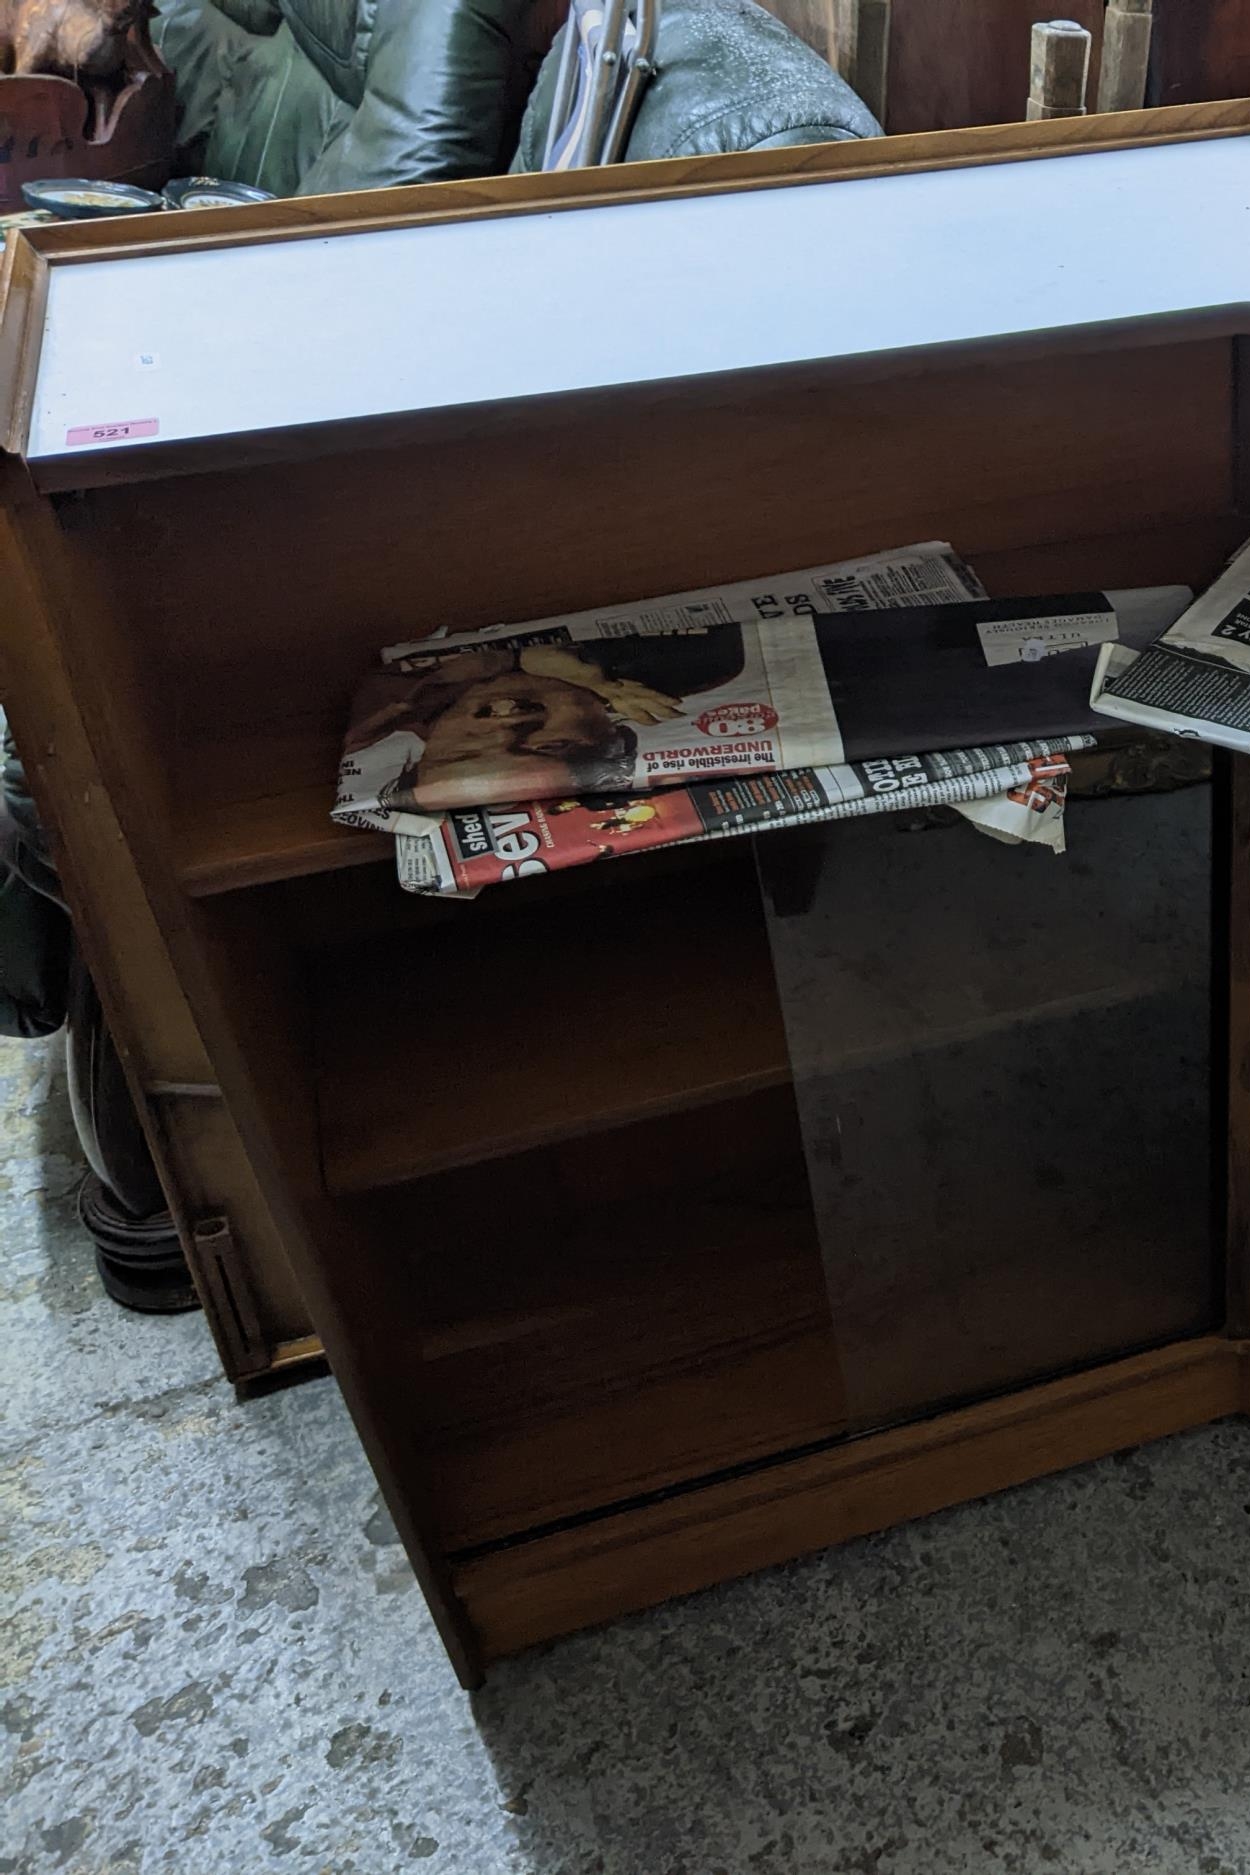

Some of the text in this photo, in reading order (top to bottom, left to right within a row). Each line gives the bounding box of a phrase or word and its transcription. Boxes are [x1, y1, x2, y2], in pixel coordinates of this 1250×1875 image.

[93, 427, 130, 438] 521
[1221, 623, 1237, 636] 2
[707, 716, 766, 738] 80
[642, 740, 772, 762] UNDERWORLD
[646, 751, 774, 772] The irresistible rise of
[455, 815, 488, 851] shed
[487, 812, 547, 880] sev
